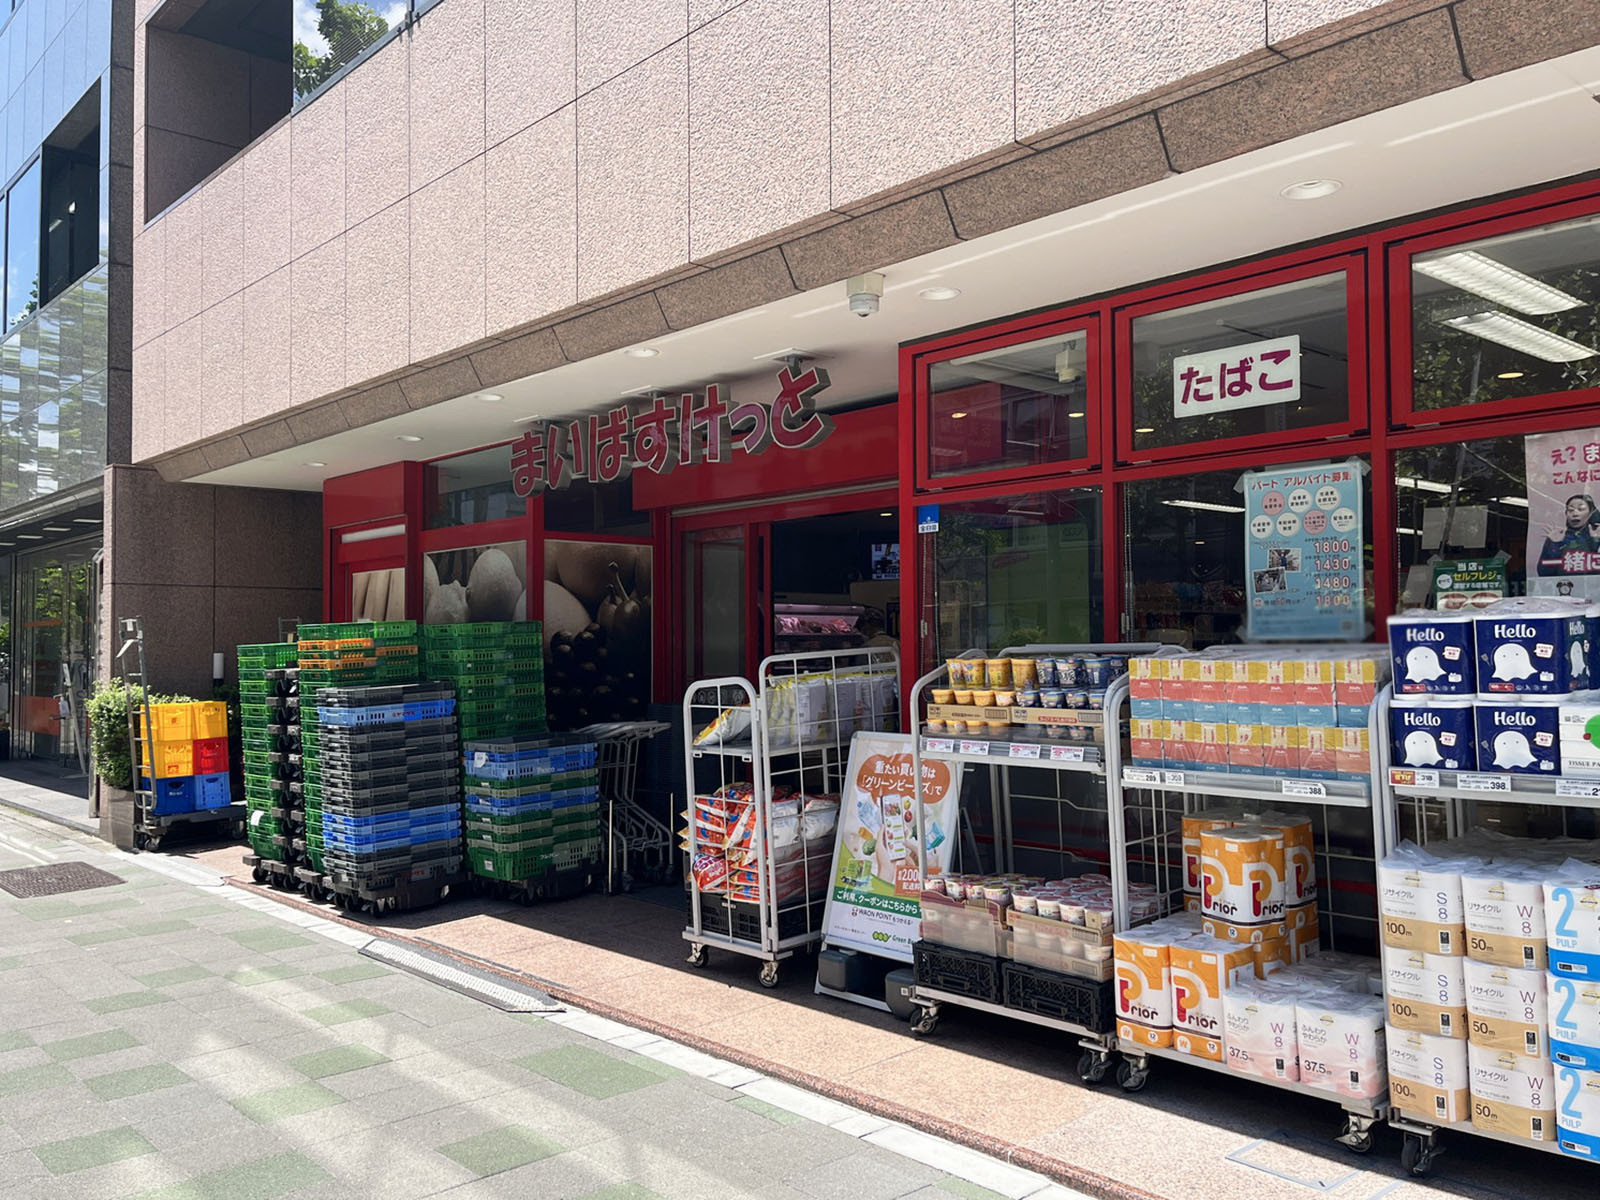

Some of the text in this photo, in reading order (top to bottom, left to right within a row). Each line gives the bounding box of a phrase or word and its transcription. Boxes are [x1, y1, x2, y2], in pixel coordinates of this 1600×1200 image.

[1180, 349, 1294, 405] たばこ
[511, 366, 829, 498] まいばすけっと
[1494, 624, 1536, 639] Hello
[1569, 620, 1585, 636] Hello
[1406, 628, 1445, 642] Hello
[1404, 712, 1441, 726] Hello
[1494, 711, 1536, 726] Hello
[1490, 782, 1506, 790] 398
[1591, 787, 1600, 796] 2
[1436, 892, 1448, 905] S
[875, 911, 892, 921] POINT
[1438, 907, 1448, 920] 8
[1516, 905, 1533, 918] W
[1552, 887, 1578, 938] 2
[1521, 921, 1532, 934] 8
[1556, 937, 1578, 949] PULP
[1437, 974, 1448, 987] S
[1439, 990, 1449, 1002] 8
[1519, 990, 1536, 1004] W
[1554, 979, 1578, 1030] 2
[1524, 1007, 1534, 1020] 8
[1271, 1022, 1285, 1034] W
[1555, 1028, 1577, 1041] PULP
[1274, 1036, 1283, 1048] 8
[1345, 1033, 1360, 1045] W
[1350, 1048, 1359, 1060] 8
[1433, 1056, 1444, 1070] S
[1434, 1072, 1444, 1085] 8
[1527, 1076, 1544, 1090] W
[1531, 1092, 1541, 1106] 8
[1559, 1067, 1582, 1119] 2
[1561, 1116, 1581, 1129] PULP
